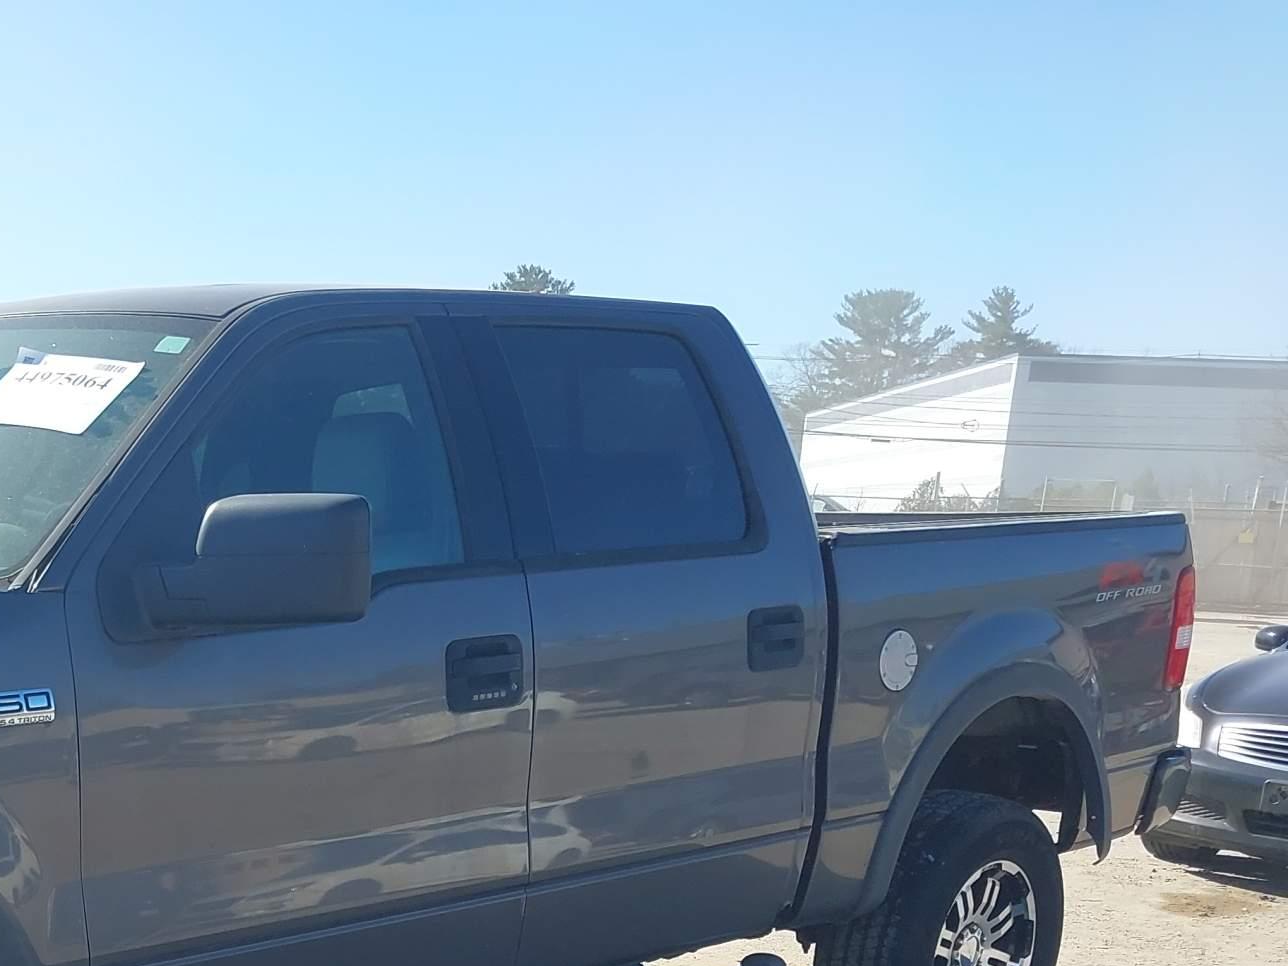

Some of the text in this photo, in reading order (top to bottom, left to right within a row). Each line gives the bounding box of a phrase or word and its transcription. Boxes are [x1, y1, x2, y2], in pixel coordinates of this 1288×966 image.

[15, 371, 114, 390] 44975064
[1095, 584, 1162, 603] OFF ROAD
[17, 715, 52, 725] TRITON
